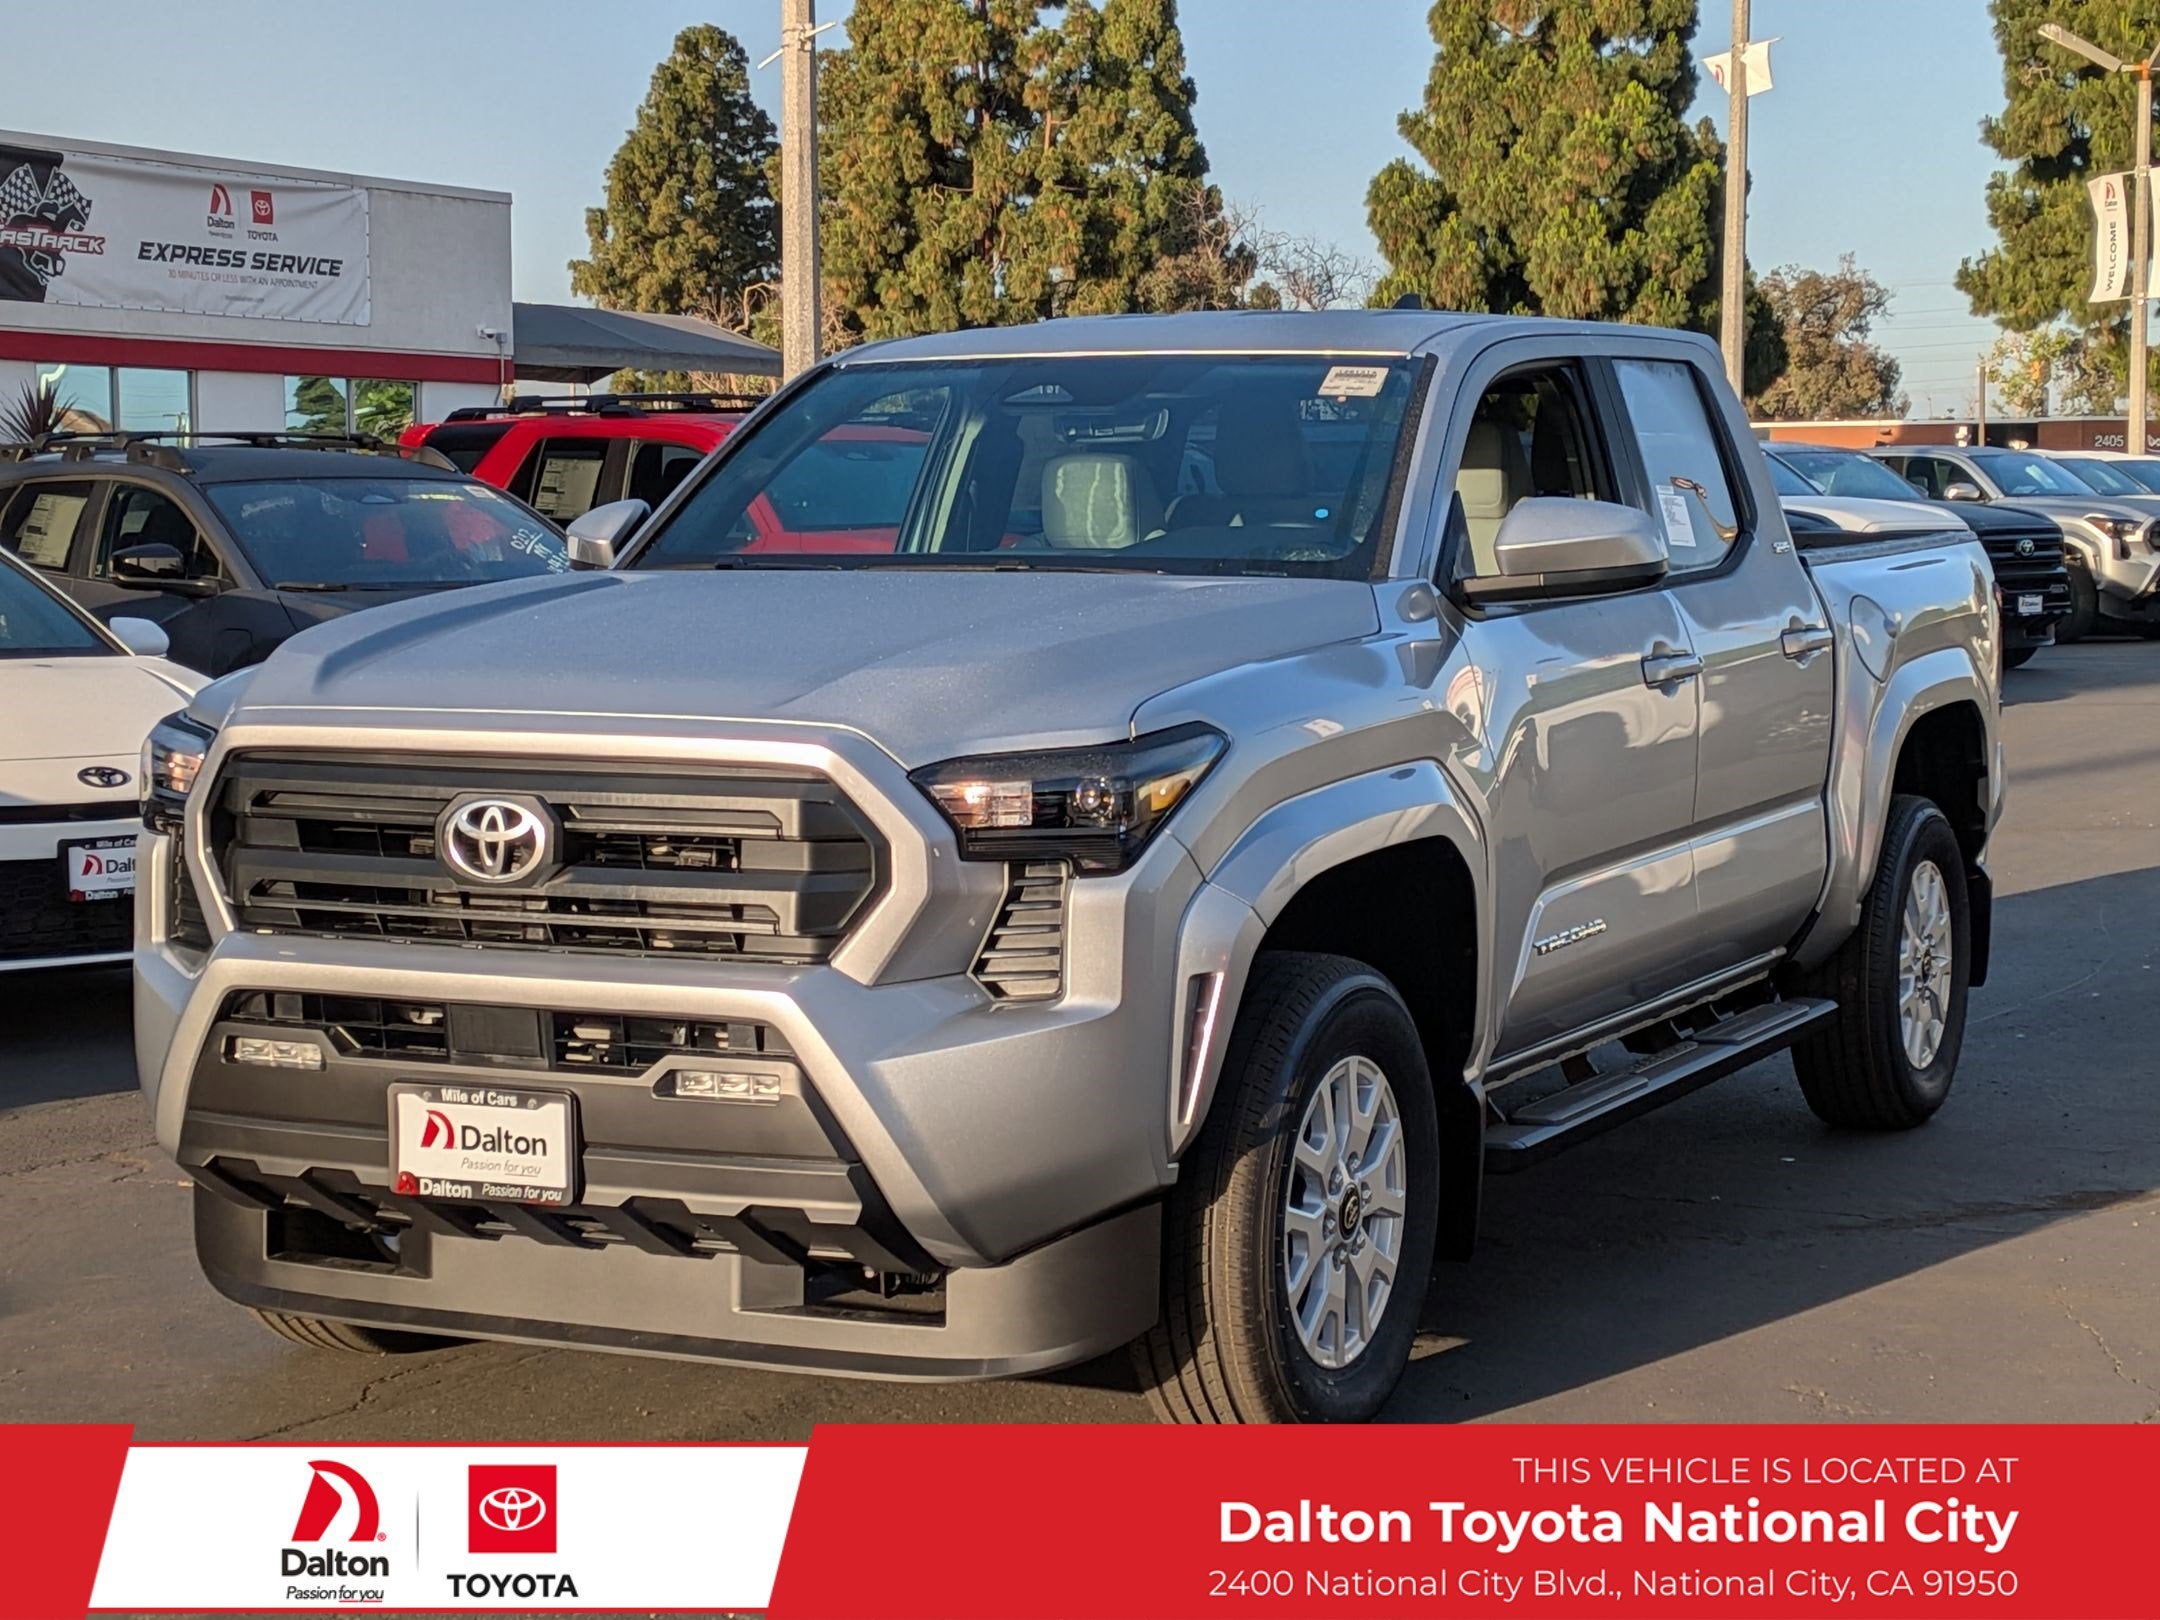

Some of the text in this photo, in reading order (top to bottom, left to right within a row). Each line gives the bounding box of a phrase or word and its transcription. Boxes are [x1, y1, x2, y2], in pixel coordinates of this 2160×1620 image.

[0, 222, 105, 254] ASTRACK
[247, 230, 279, 242] TOYOTA
[137, 241, 344, 278] EXPRESS SERVICE
[2105, 221, 2118, 292] WELCOME
[2094, 434, 2125, 448] 2405
[106, 857, 136, 874] Dal
[440, 1087, 518, 1108] Mile of Cars
[461, 1125, 547, 1157] Dalton
[461, 1157, 541, 1176] Passion for you
[419, 1178, 472, 1198] Dalton
[482, 1183, 562, 1202] Passion for you
